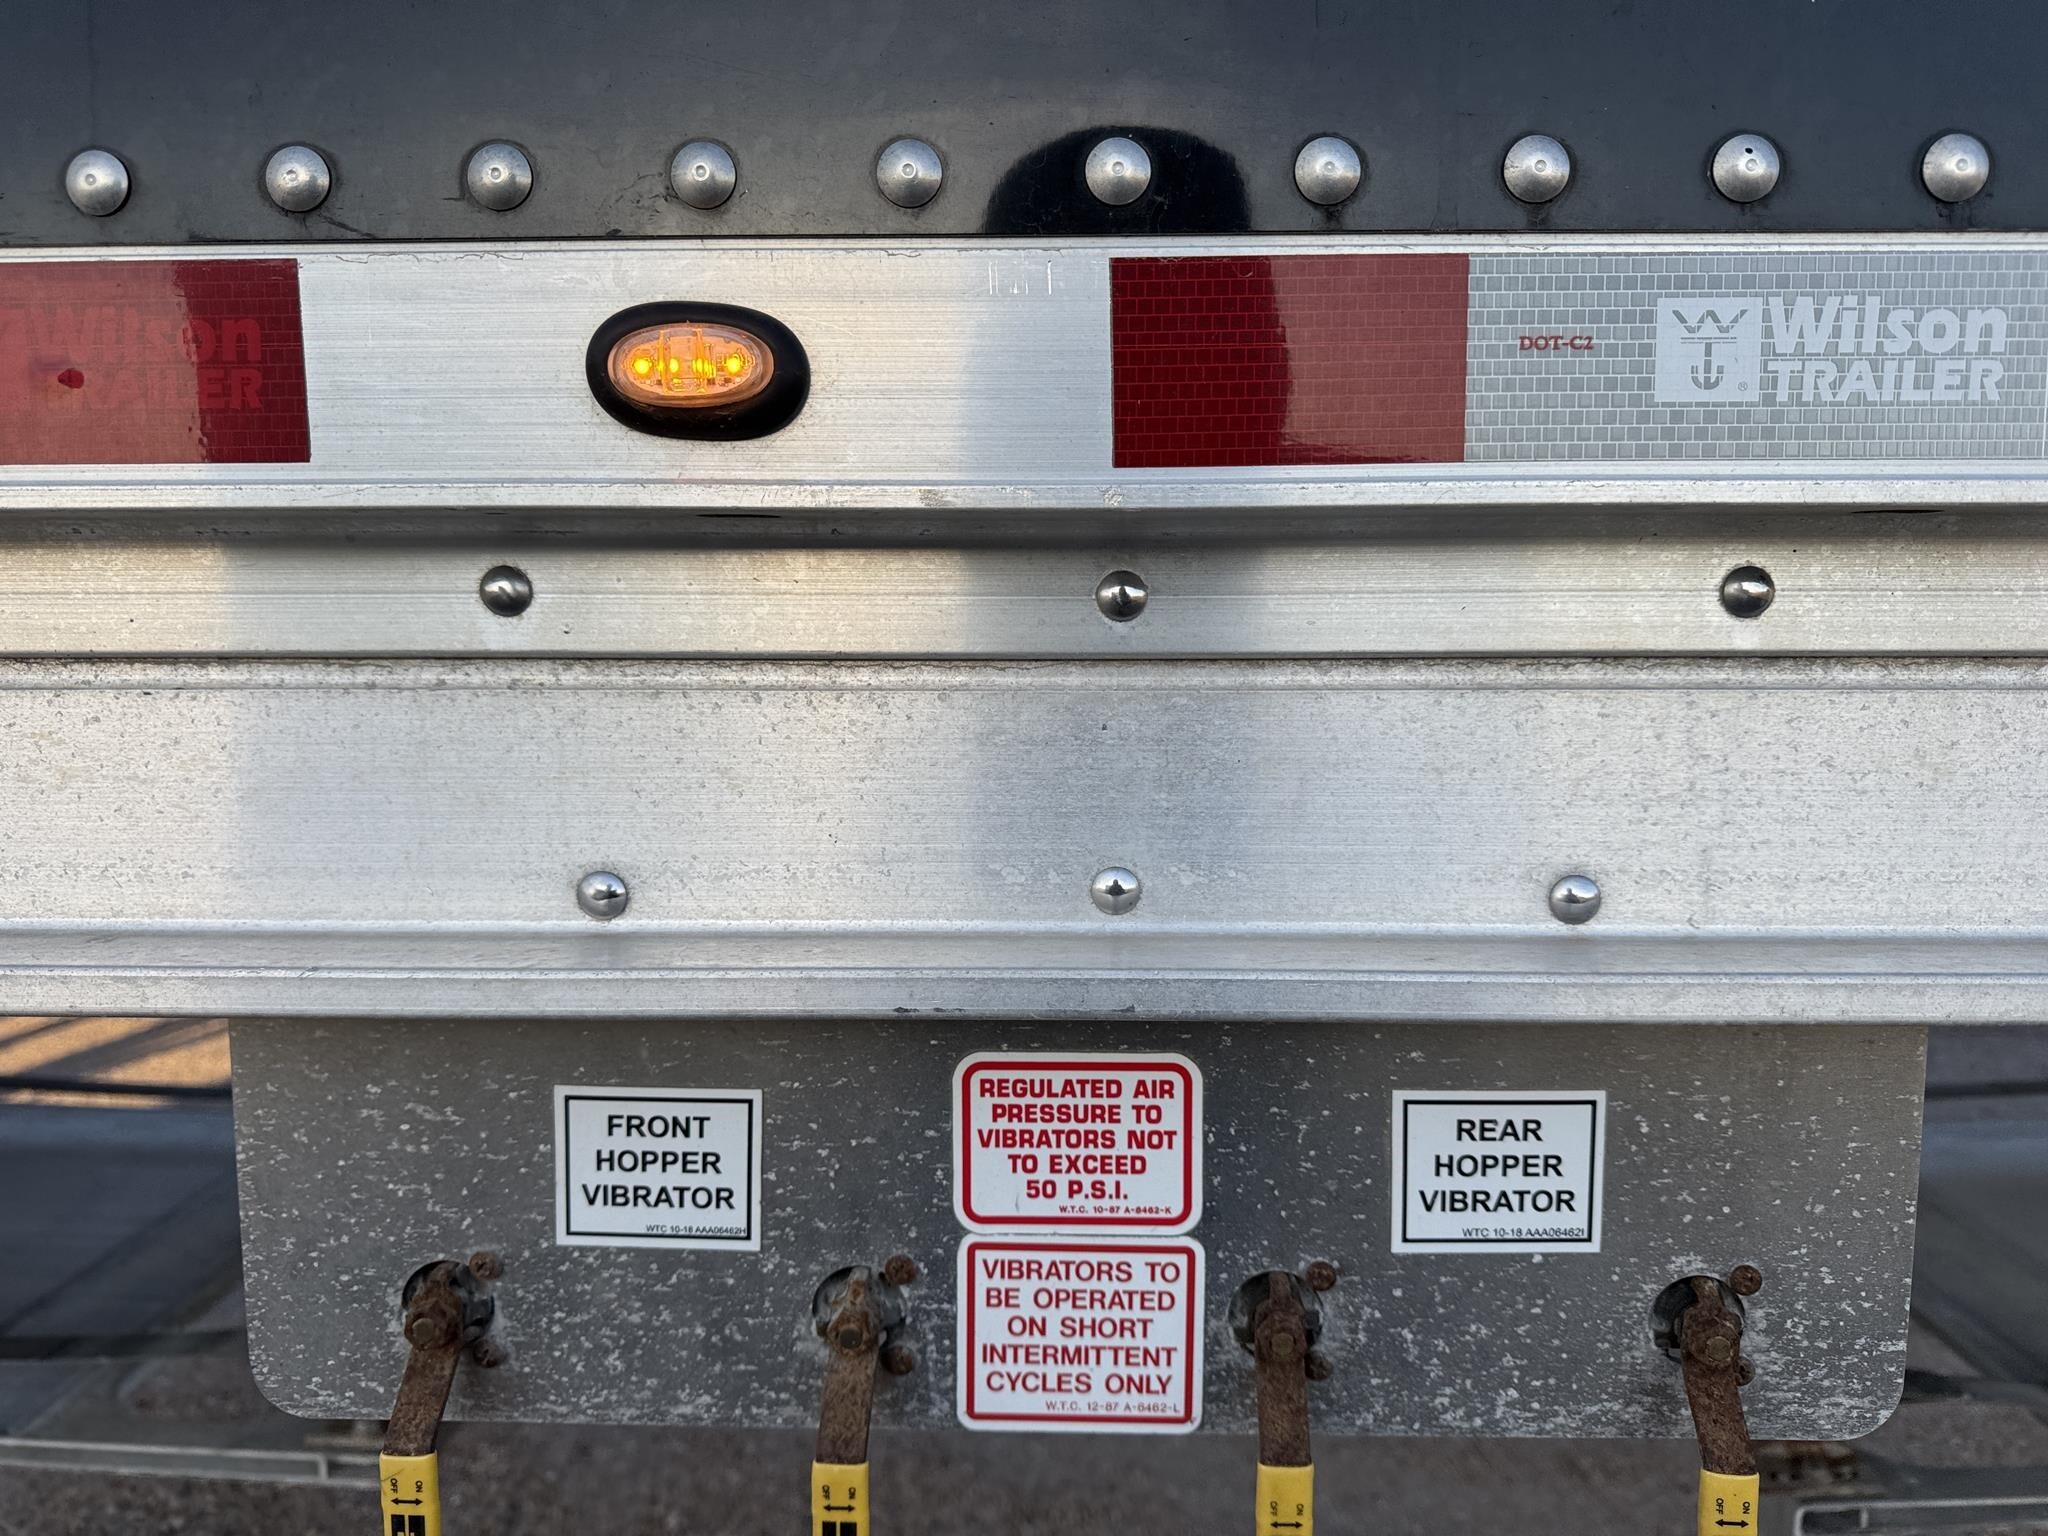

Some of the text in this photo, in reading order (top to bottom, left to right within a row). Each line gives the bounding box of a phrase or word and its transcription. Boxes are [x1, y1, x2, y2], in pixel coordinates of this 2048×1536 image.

[1766, 295, 2008, 354] Wilson
[1518, 334, 1595, 352] DOT-C2
[1766, 359, 2005, 402] TRAILER
[979, 1078, 1175, 1100] REGULATED AIR
[991, 1103, 1163, 1125] PRESSURE TO
[607, 1114, 711, 1139] FRONT
[1456, 1118, 1543, 1142] REAR
[977, 1128, 1178, 1150] VIBRATORS NOT
[596, 1149, 722, 1175] HOPPER
[1007, 1153, 1147, 1175] TO EXCEED
[1434, 1154, 1564, 1178] HOPPER
[581, 1183, 735, 1210] VIBRATOR
[1026, 1179, 1128, 1200] 50 P.S.I.
[1058, 1205, 1089, 1214] W.T.C.
[1418, 1189, 1576, 1213] VIBRATOR
[645, 1224, 668, 1234] WTC
[669, 1225, 695, 1235] 10-18
[1461, 1227, 1490, 1238] WTC
[1493, 1227, 1525, 1238] 10-18
[982, 1258, 1181, 1284] VIBRATORS TO
[985, 1287, 1176, 1312] BE OPERATED
[1007, 1315, 1154, 1339] ON SHORT
[982, 1343, 1178, 1368] INTERMITTENT
[986, 1370, 1172, 1395] CYCLES ONLY
[1045, 1400, 1081, 1412] W.T.C.
[1087, 1401, 1119, 1412] 12-87
[390, 1477, 398, 1494] OFF
[415, 1480, 423, 1493] ON
[1715, 1497, 1724, 1515] OFF
[1742, 1501, 1751, 1515] ON
